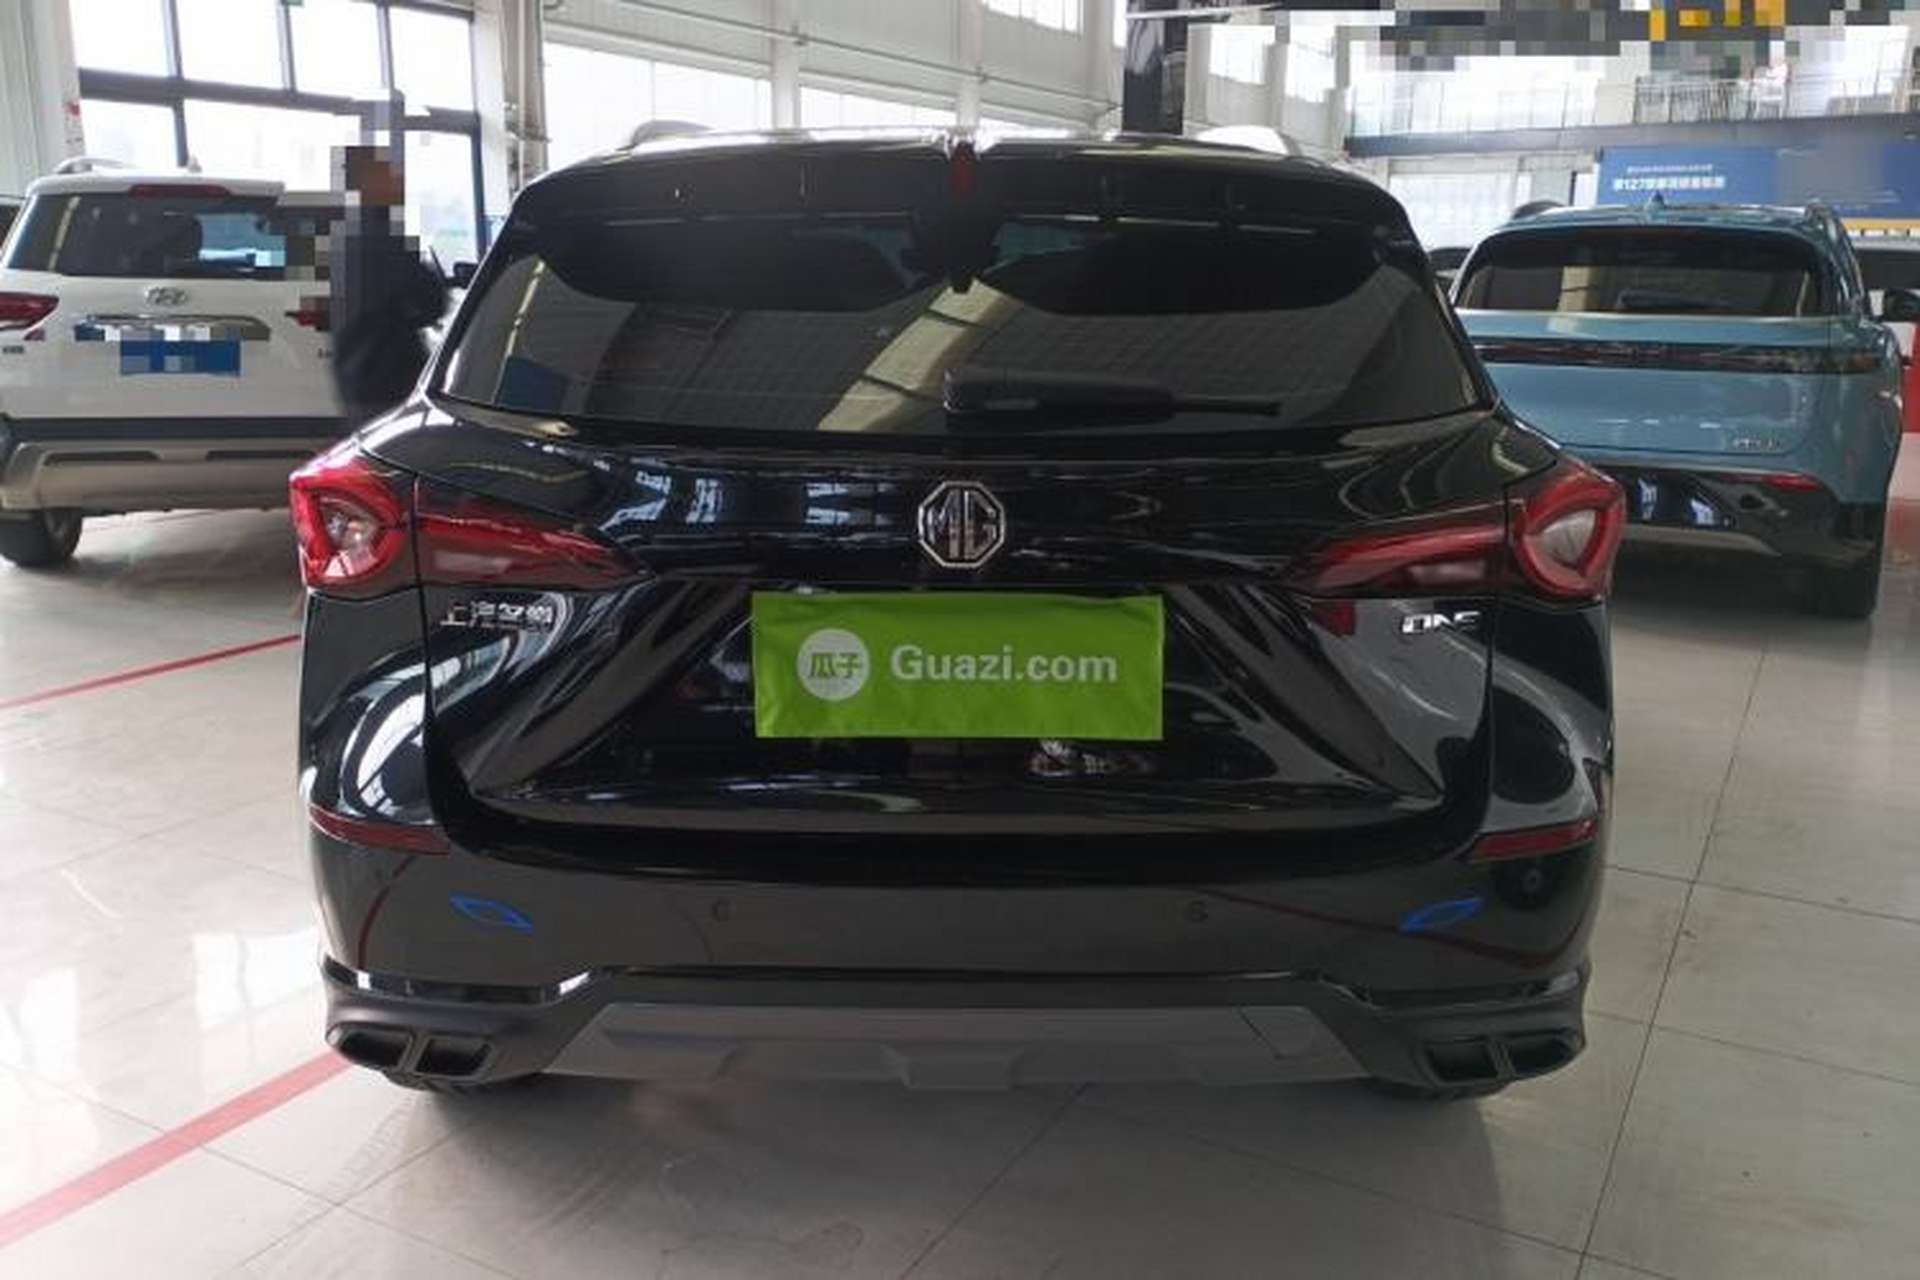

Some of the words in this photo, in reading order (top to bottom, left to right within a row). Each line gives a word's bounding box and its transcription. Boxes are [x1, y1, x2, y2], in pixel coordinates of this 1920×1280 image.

[927, 489, 997, 560] MG
[808, 652, 860, 679] 瓜子
[892, 645, 1118, 682] Guazi.com
